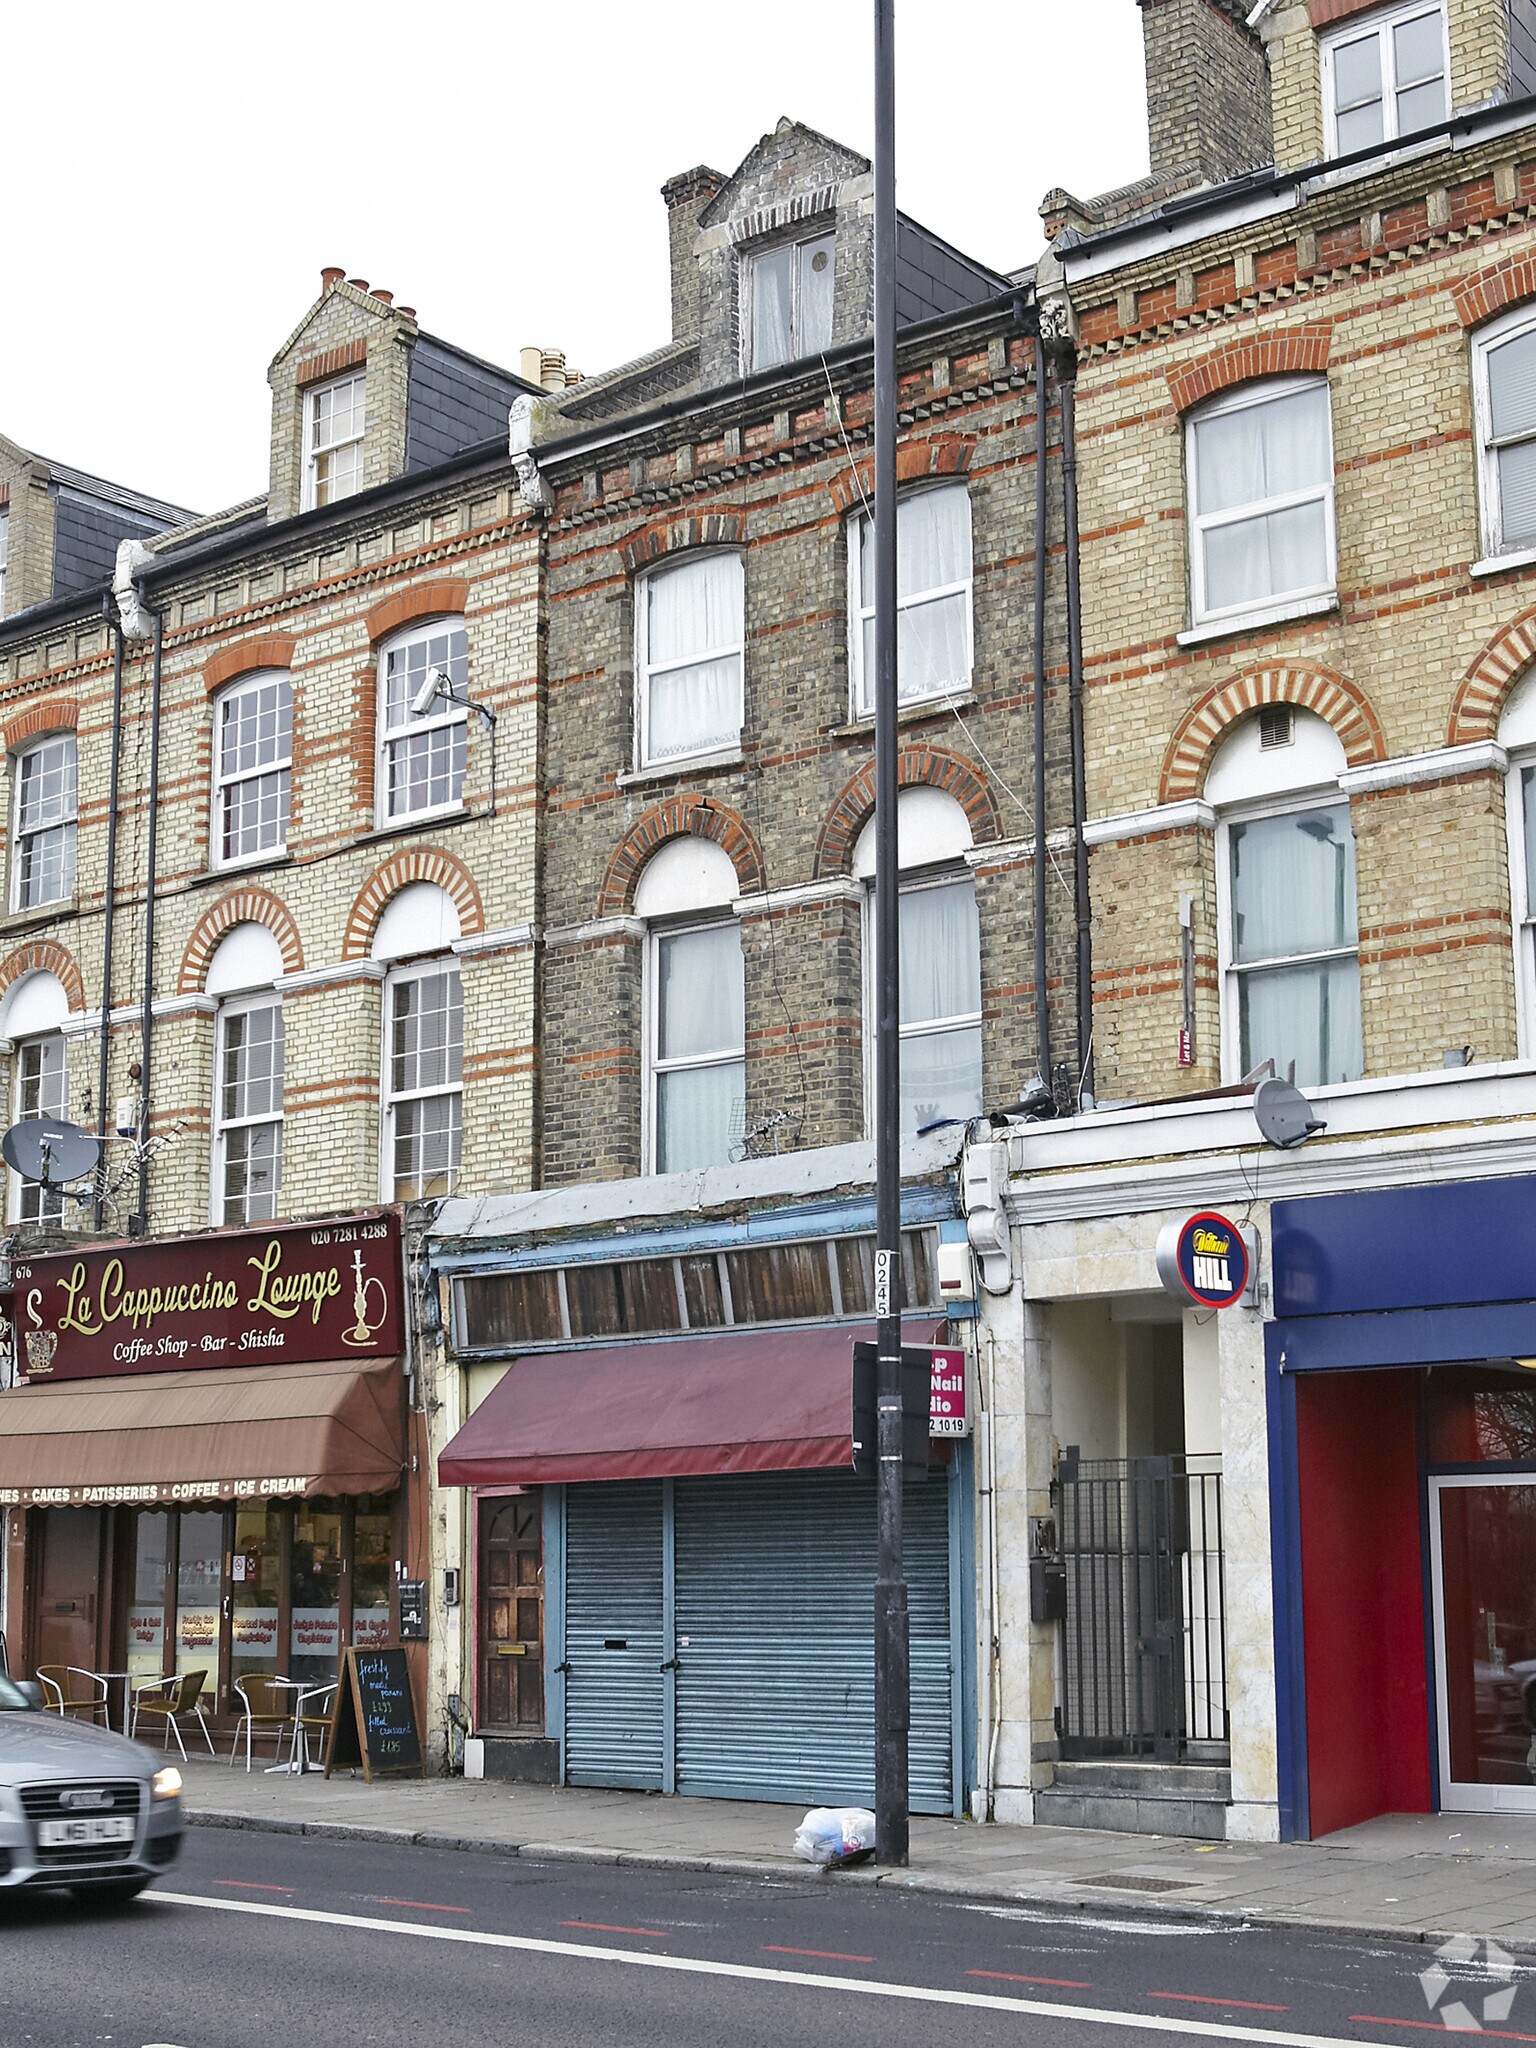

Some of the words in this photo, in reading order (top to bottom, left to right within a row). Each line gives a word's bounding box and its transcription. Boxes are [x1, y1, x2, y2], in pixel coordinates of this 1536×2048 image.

[311, 1230, 330, 1245] 020
[333, 1227, 357, 1242] 7281
[361, 1223, 387, 1239] 4288
[16, 1265, 32, 1279] 676
[878, 1253, 887, 1315] 0245
[1193, 1256, 1233, 1291] HILL
[57, 1262, 102, 1335] La
[100, 1258, 238, 1329] Cappuccino
[247, 1240, 341, 1324] Lounge
[113, 1338, 153, 1363] Coffee
[155, 1335, 188, 1358] Shop
[200, 1335, 227, 1352] Bar
[238, 1327, 285, 1350] Shisha
[931, 1375, 963, 1391] Nail
[940, 1419, 963, 1431] 1019
[32, 1488, 70, 1502] CAKES
[82, 1486, 158, 1501] PATISSERIES
[172, 1482, 219, 1498] COFFEE
[234, 1480, 255, 1495] ICE
[260, 1477, 306, 1493] CREAM
[360, 1659, 389, 1684] freshly
